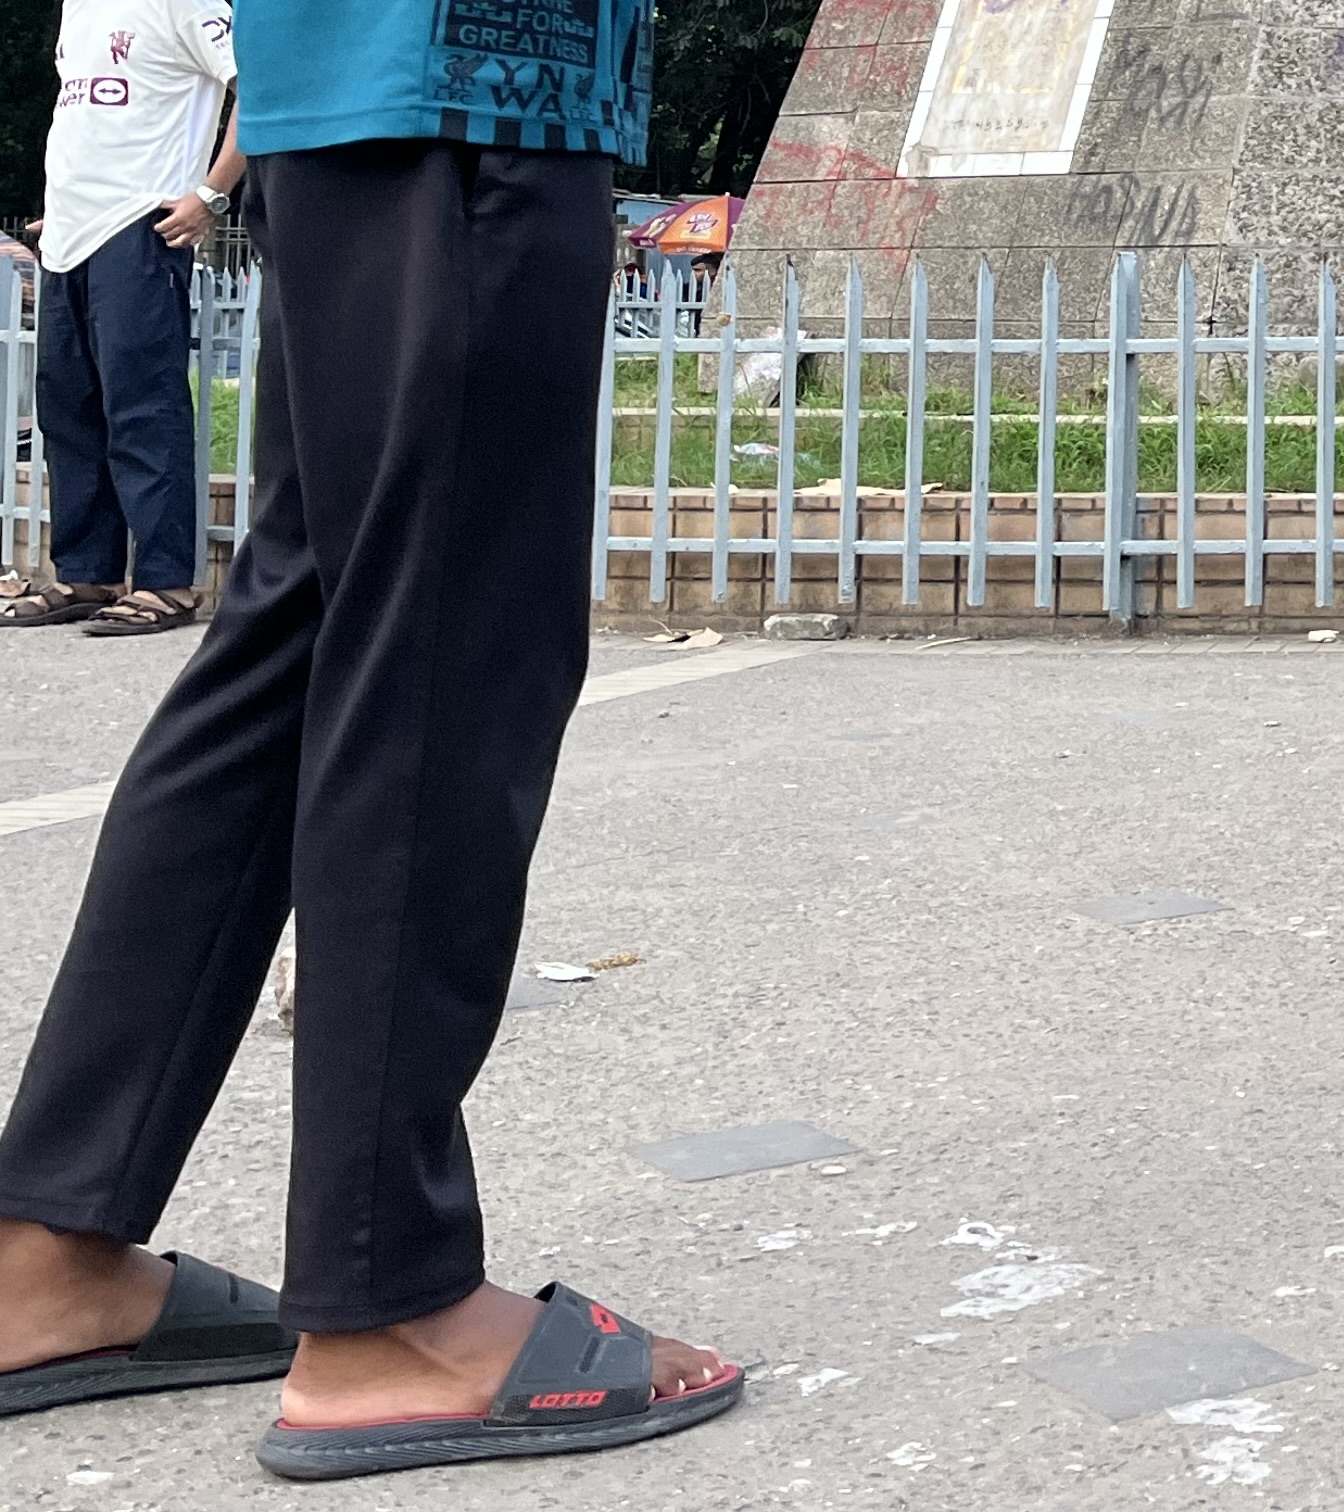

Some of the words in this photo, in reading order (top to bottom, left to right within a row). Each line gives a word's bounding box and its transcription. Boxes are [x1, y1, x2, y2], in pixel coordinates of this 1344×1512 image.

[517, 8, 566, 34] FOR
[459, 24, 588, 62] GREATNESS
[529, 1390, 607, 1409] LOTTO
